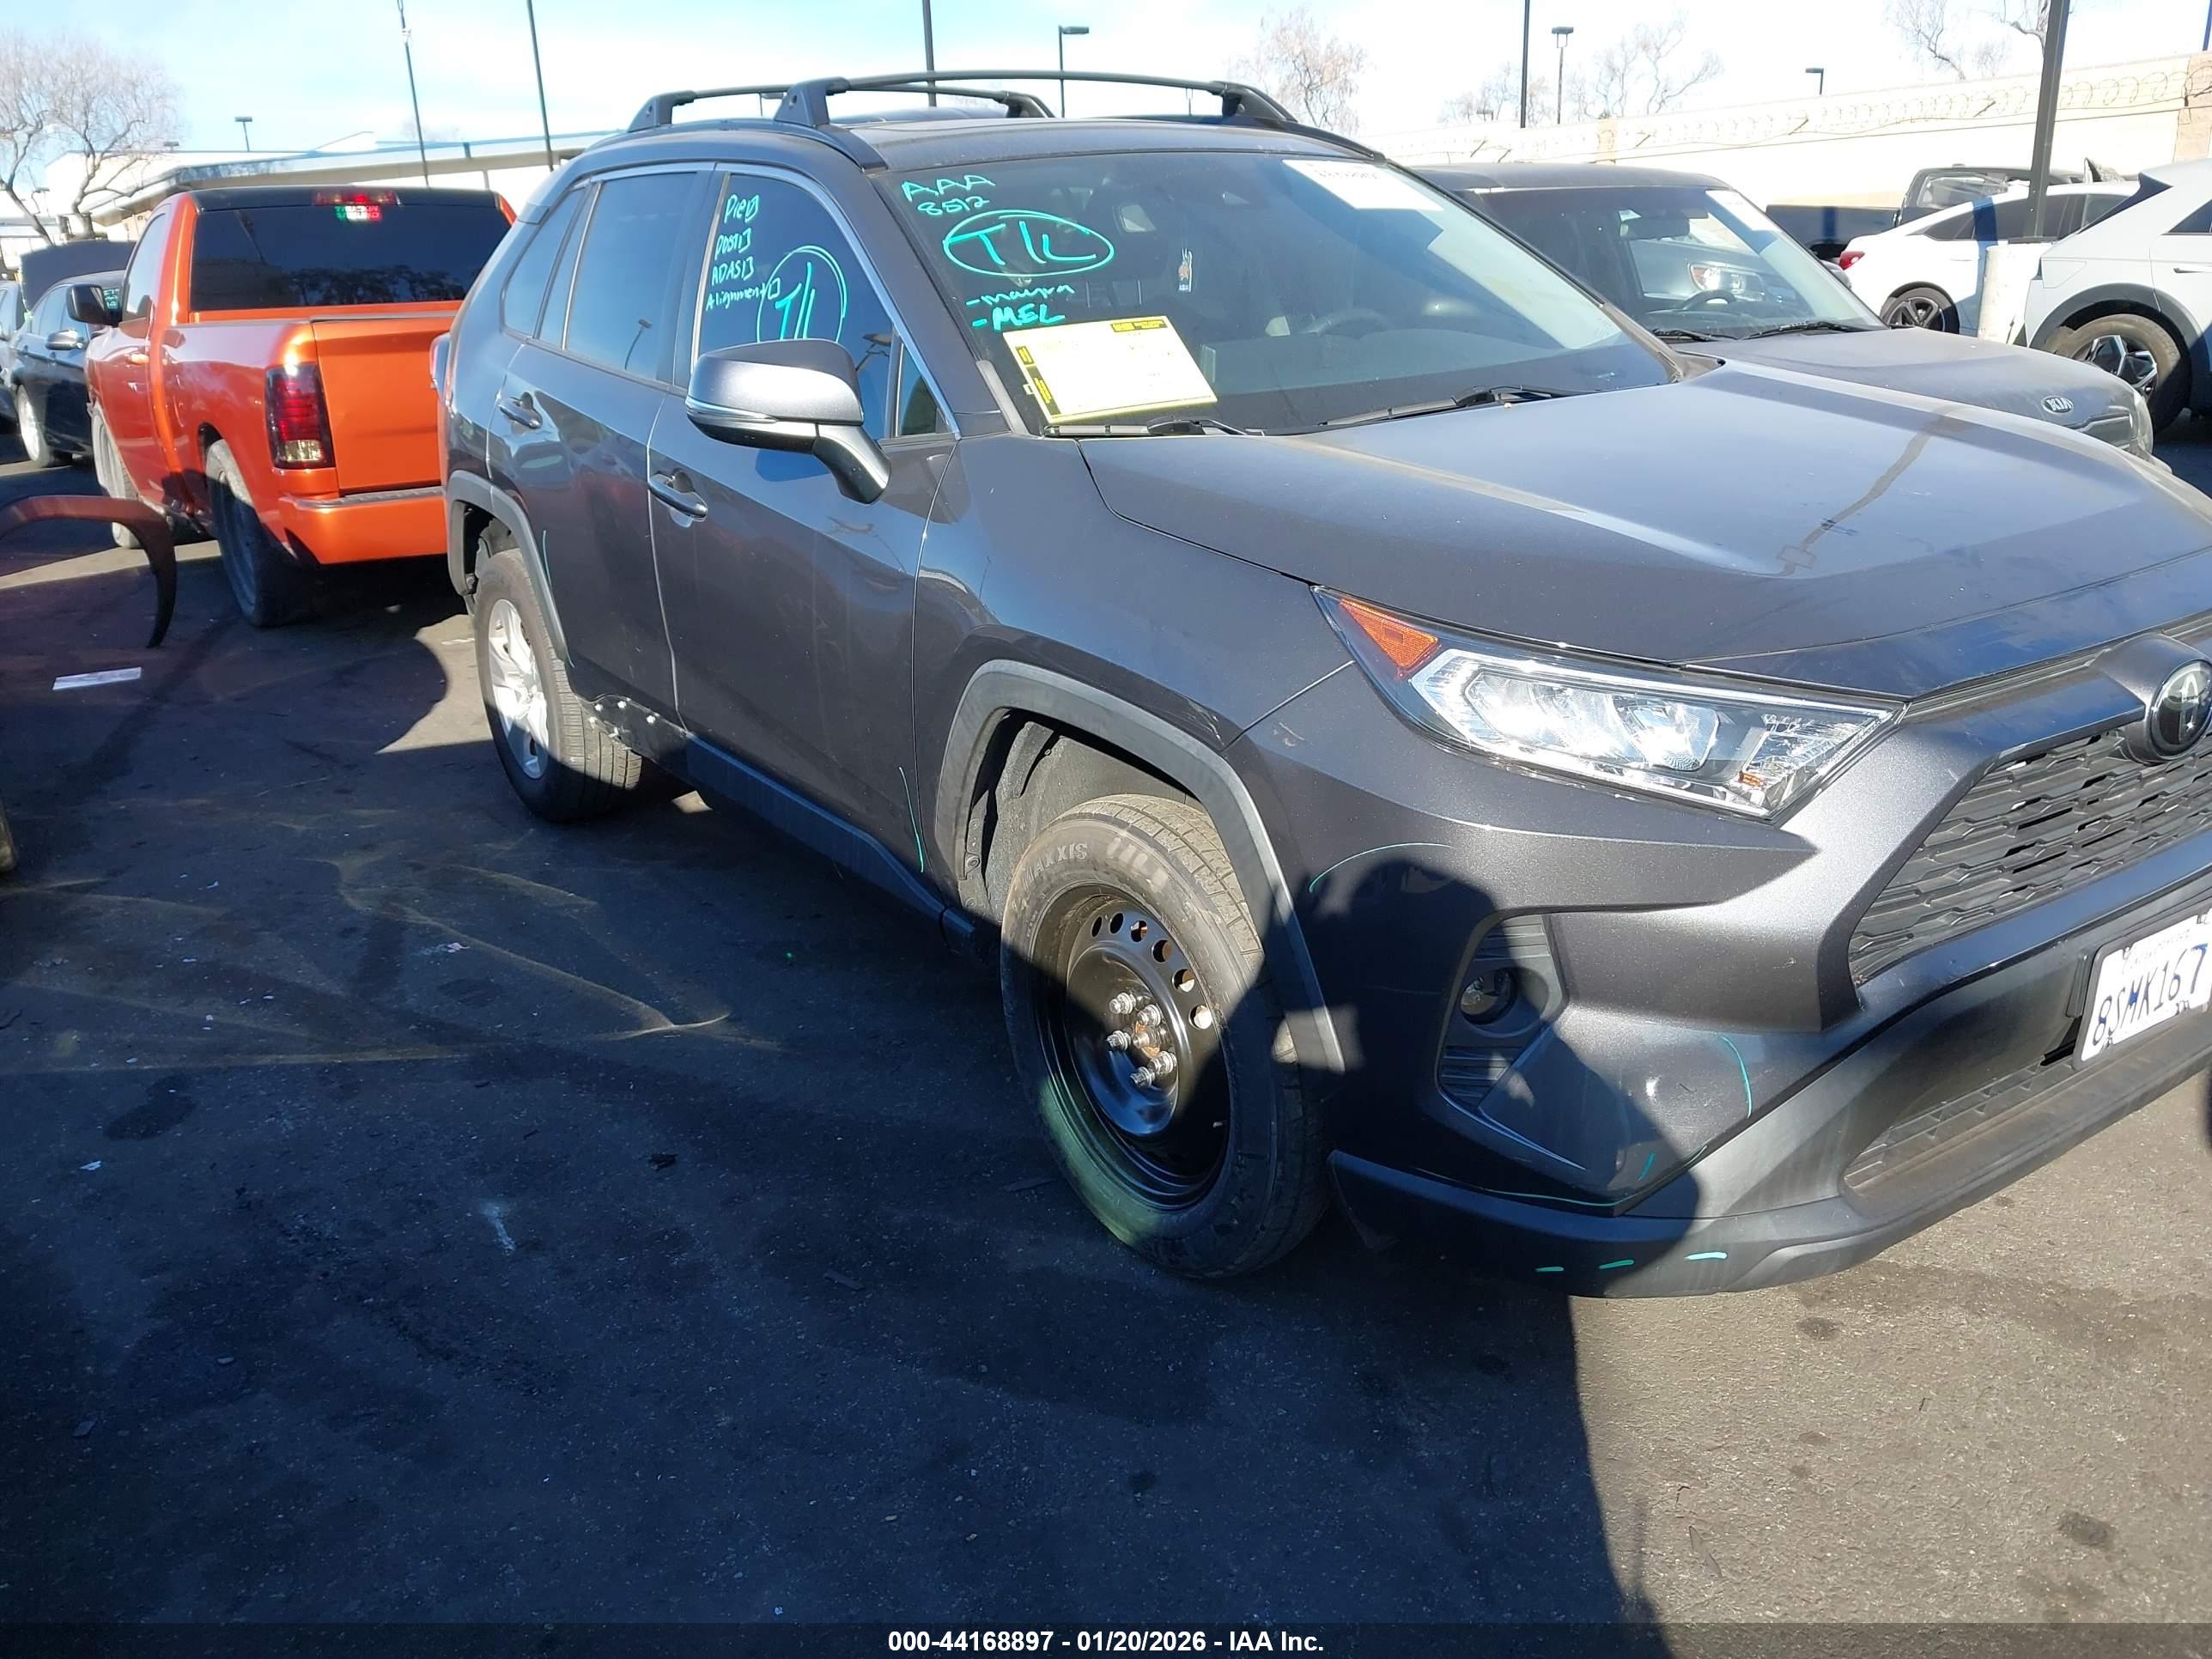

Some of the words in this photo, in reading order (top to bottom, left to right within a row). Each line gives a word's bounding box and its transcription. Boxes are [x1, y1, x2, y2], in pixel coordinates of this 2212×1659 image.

[902, 174, 995, 202] AAA
[917, 196, 989, 216] 8512
[2045, 398, 2073, 411] KIA
[2092, 943, 2209, 1047] 8SMK167
